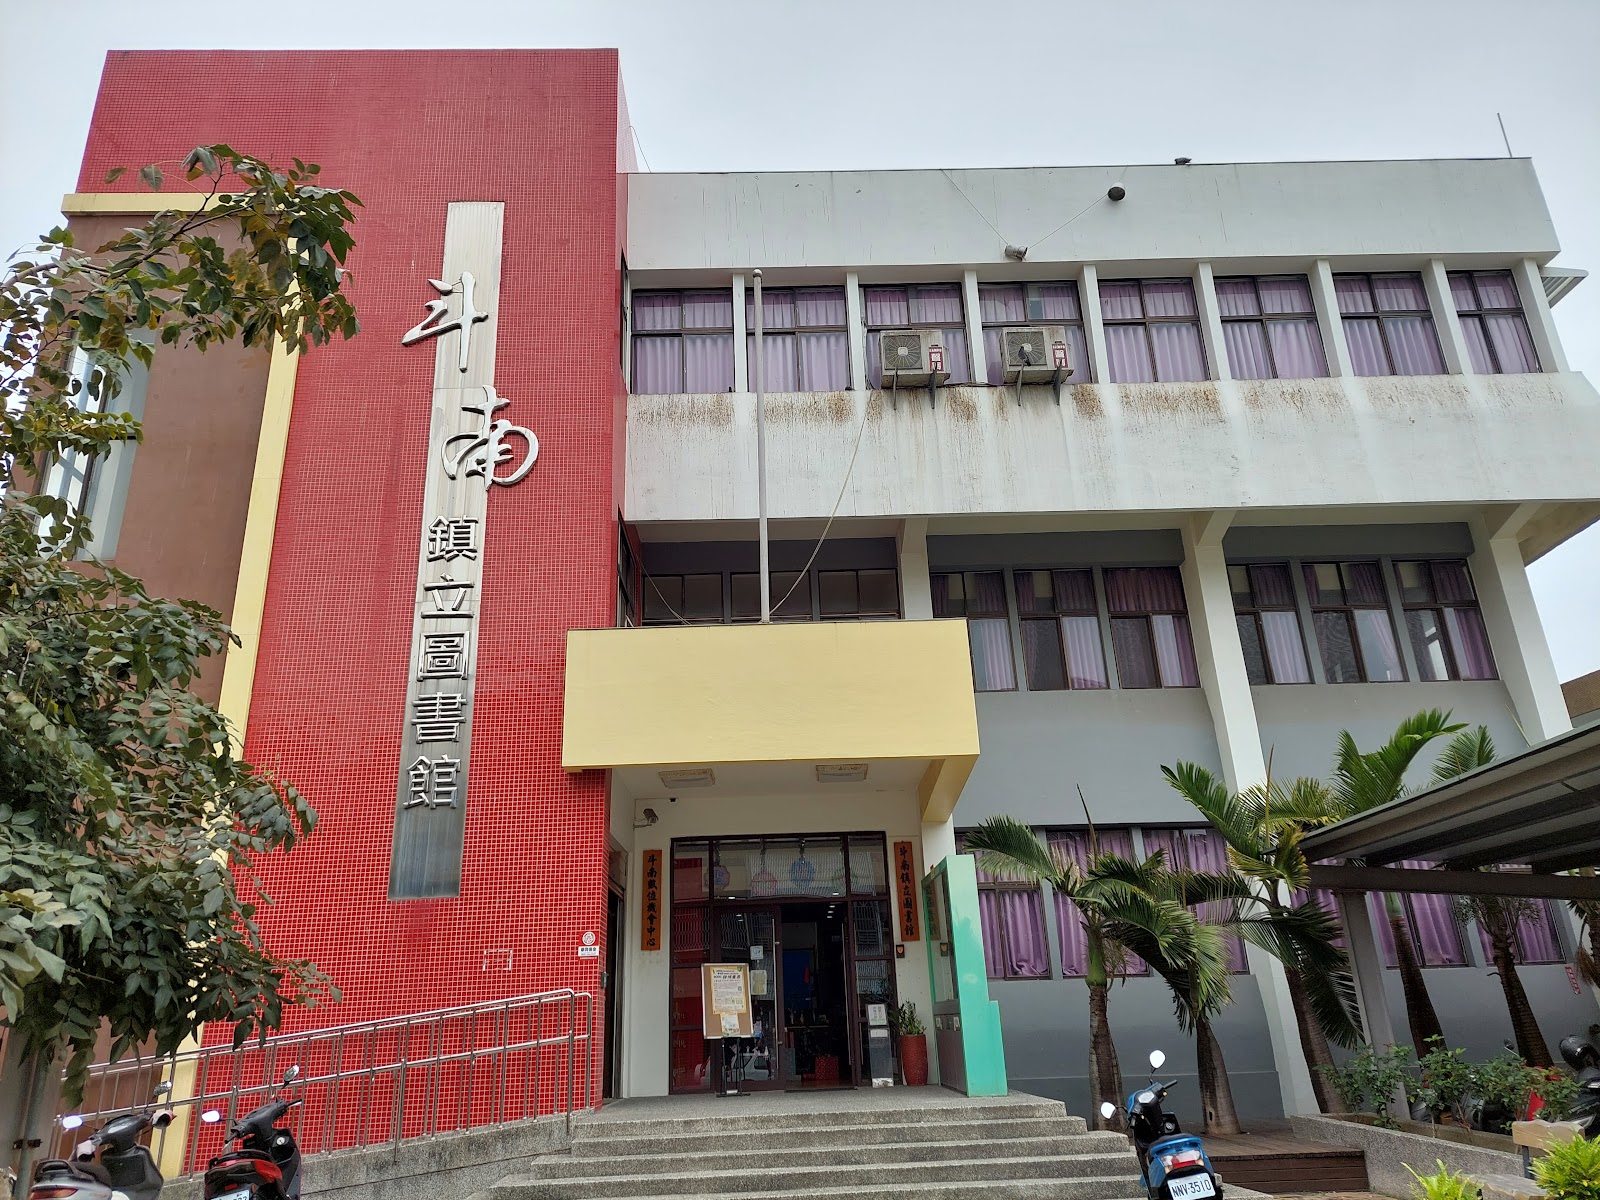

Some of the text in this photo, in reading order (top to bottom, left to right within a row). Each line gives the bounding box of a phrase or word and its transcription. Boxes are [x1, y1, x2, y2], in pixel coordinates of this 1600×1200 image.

[402, 271, 539, 810] 斗南鎮立圖書館
[646, 853, 658, 947] 斗南數位機會中心
[900, 845, 914, 936] 斗南鎮立圖書館
